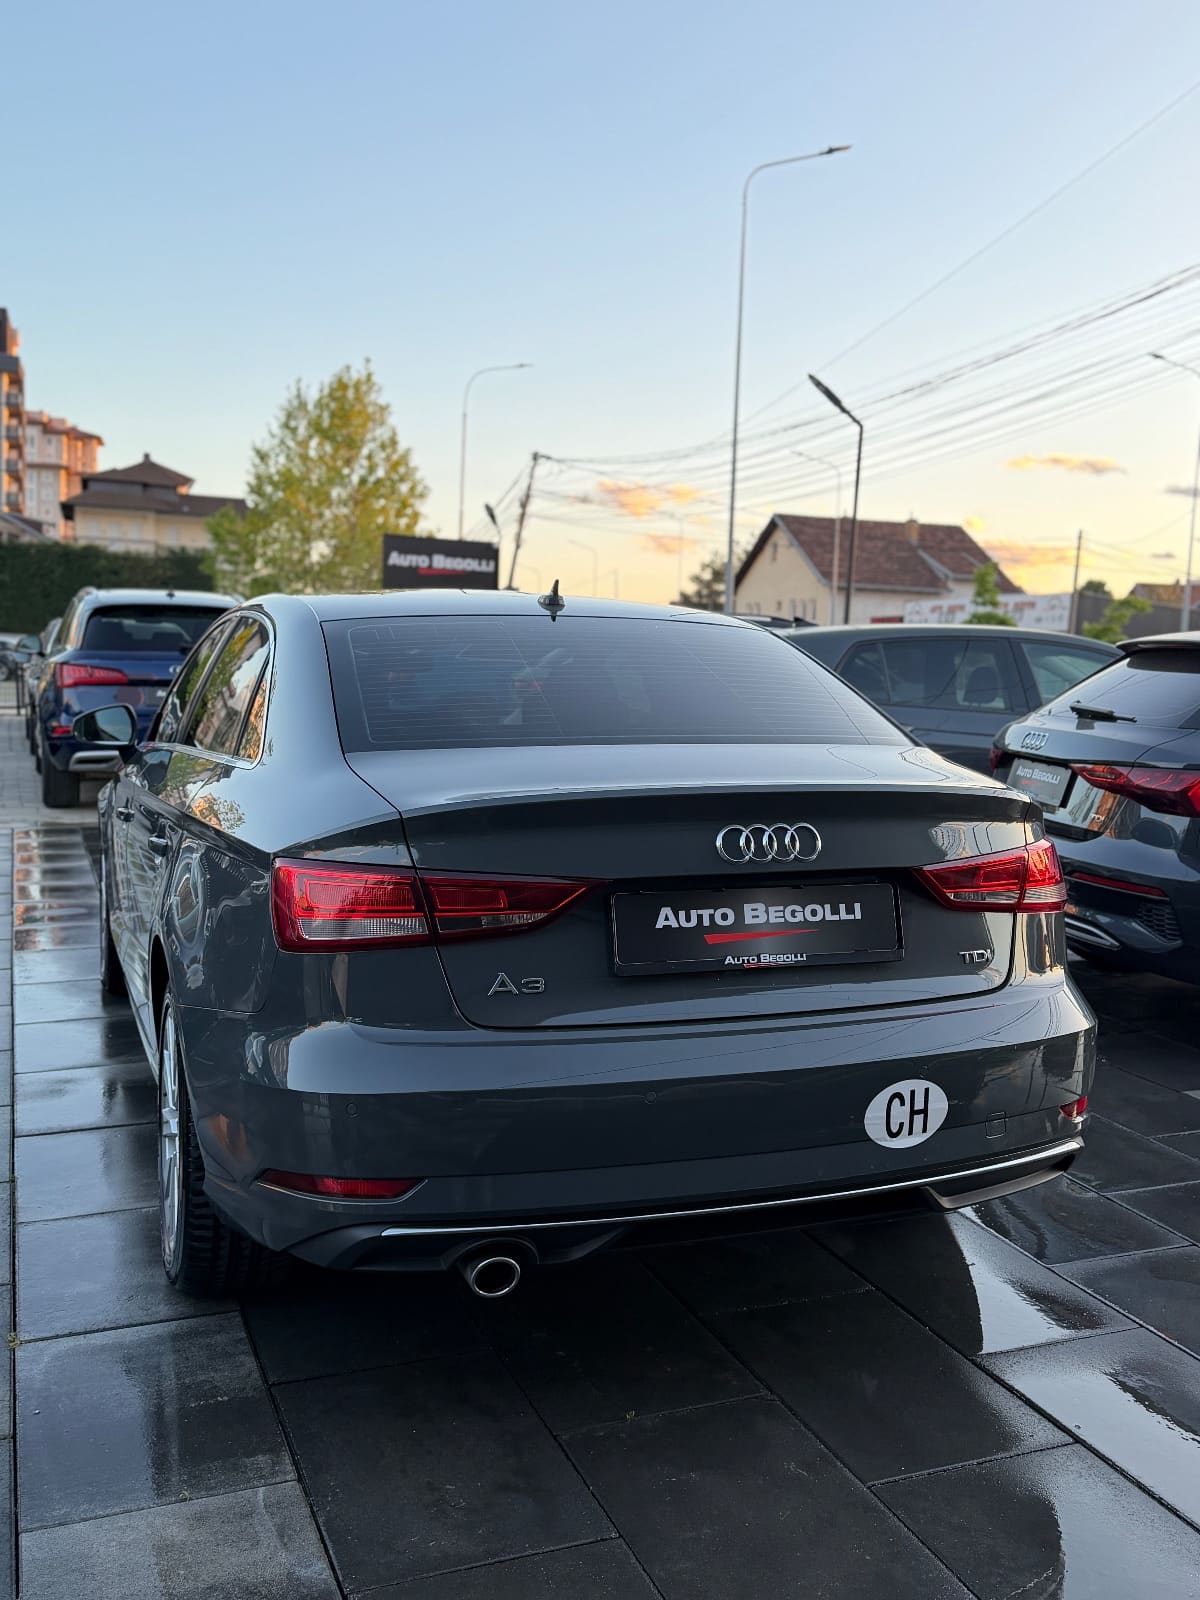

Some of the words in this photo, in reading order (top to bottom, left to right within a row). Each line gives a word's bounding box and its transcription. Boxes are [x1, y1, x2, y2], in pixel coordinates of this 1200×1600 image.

[387, 550, 430, 568] AUTO
[432, 553, 496, 573] BEGOLLI
[1016, 766, 1032, 778] AUTO
[655, 906, 735, 928] AUTO
[743, 902, 862, 924] BEGOLLI
[724, 955, 758, 964] AUTO
[760, 953, 807, 963] BEGOLLI
[959, 949, 992, 964] TDI
[487, 972, 545, 996] A3
[885, 1087, 930, 1139] CH
